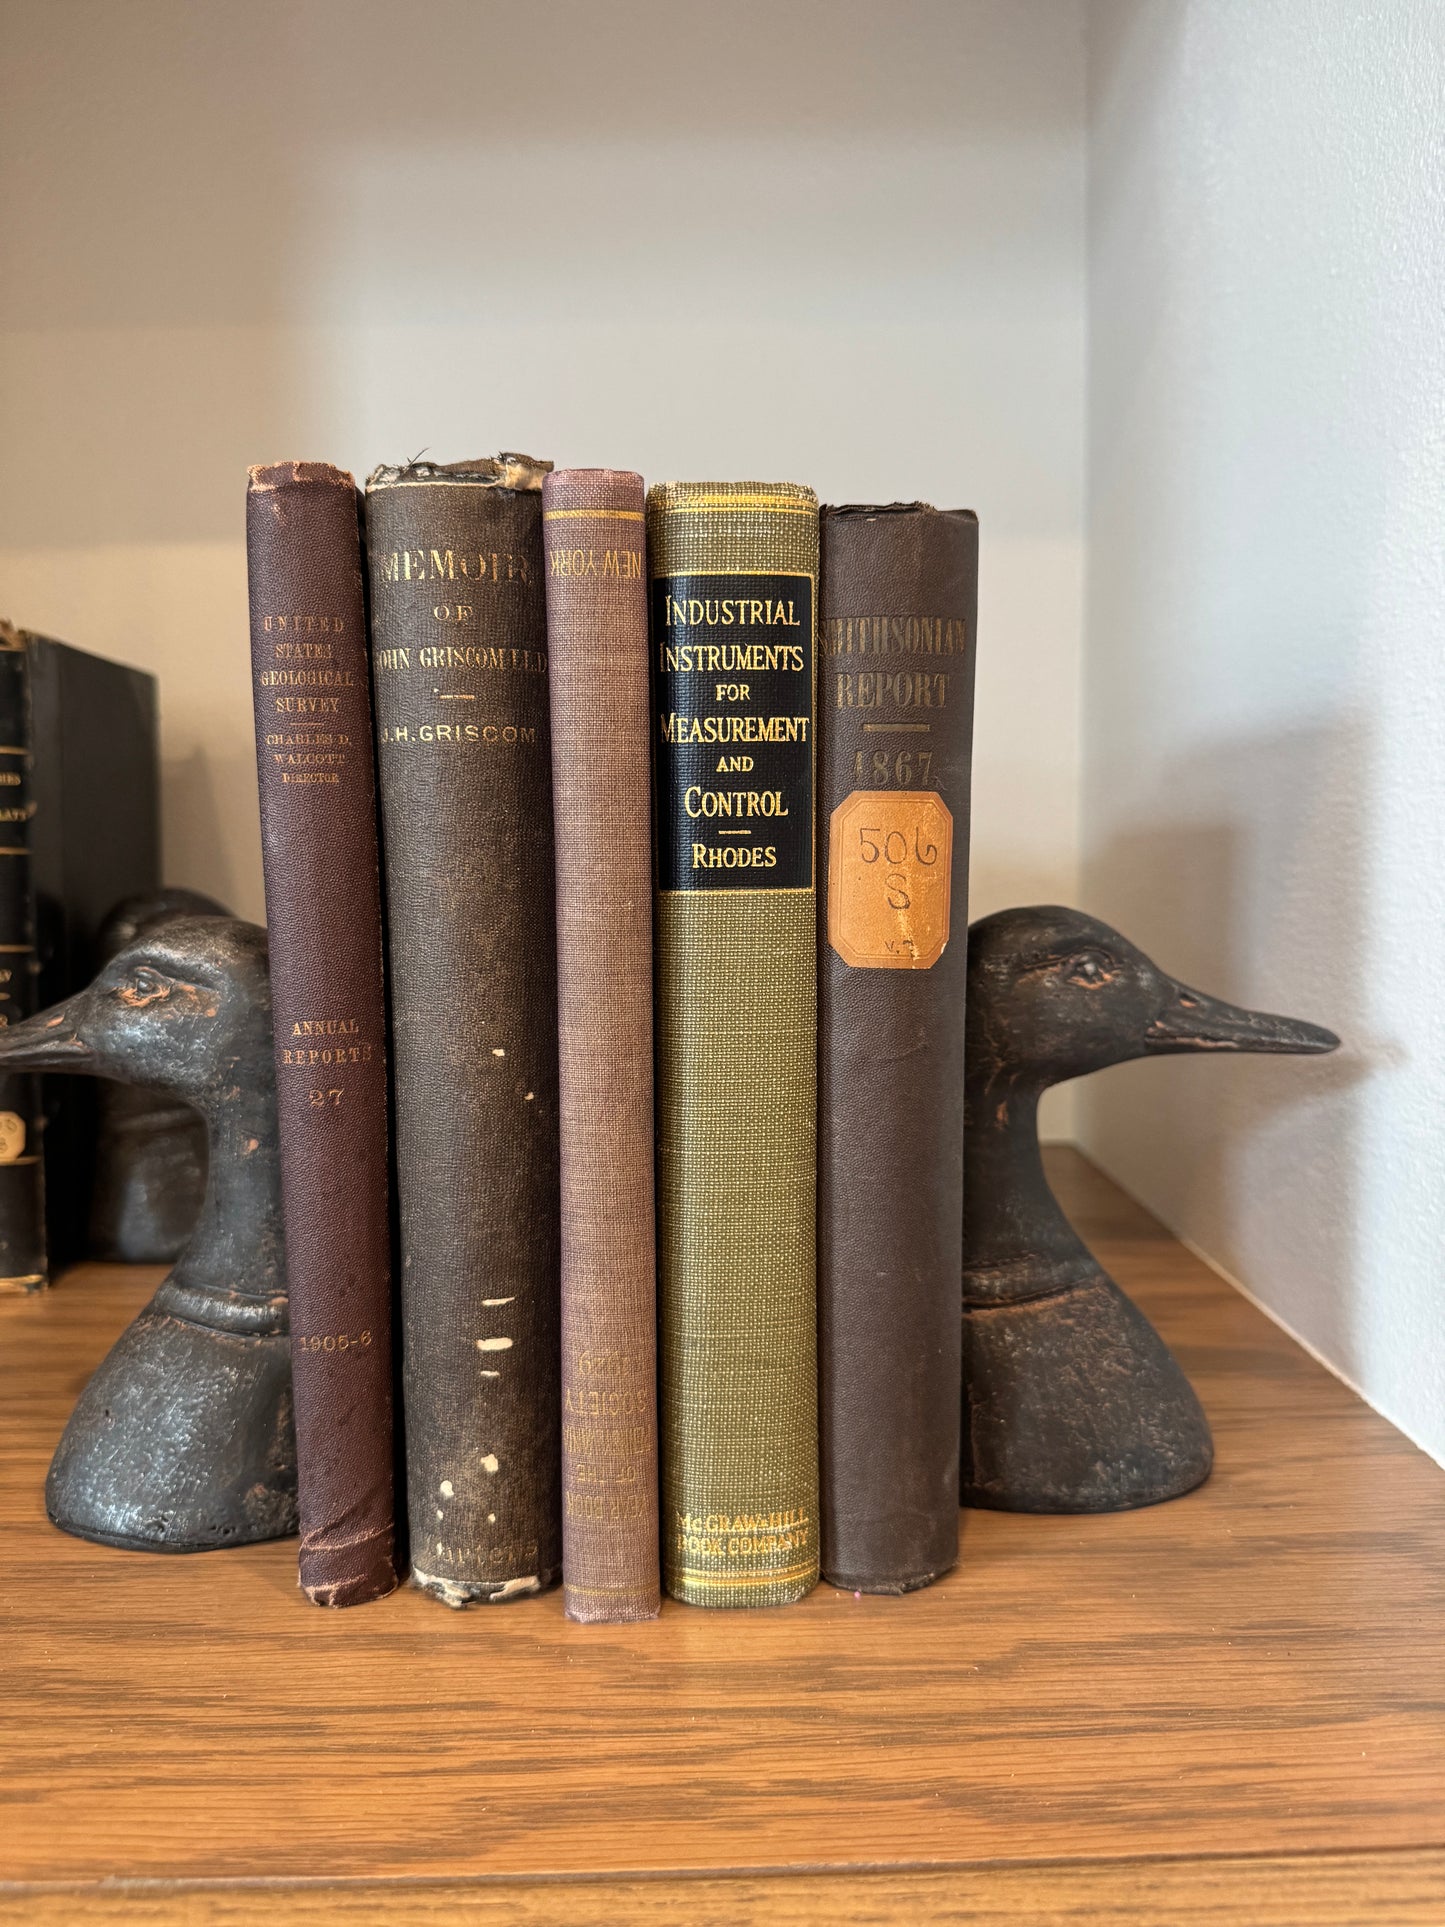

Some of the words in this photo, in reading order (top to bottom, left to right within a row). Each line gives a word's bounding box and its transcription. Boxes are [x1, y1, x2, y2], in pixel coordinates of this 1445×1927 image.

[381, 550, 531, 584] MEMOIR
[550, 549, 598, 576] YORK
[603, 549, 641, 578] NEW
[434, 605, 473, 621] OF
[665, 596, 800, 626] INDUSTRIAL
[264, 616, 344, 633] UNITED
[822, 616, 967, 656] SMITHSONIAN
[275, 643, 332, 659] STATES
[419, 646, 505, 671] GRISCOM
[660, 644, 804, 672] INSTRUMENTS
[261, 671, 353, 686] GEOLOGICAL
[836, 672, 950, 709] REPORT
[716, 684, 749, 700] FOR
[276, 698, 340, 712] SURVEY
[266, 735, 332, 745] CHARLES
[661, 713, 809, 743] MEASUREMENT
[273, 754, 345, 765] WALCOTT
[716, 757, 753, 772] AND
[854, 751, 933, 786] 1867
[685, 786, 788, 817] CONTROL
[692, 842, 777, 868] RHODES
[858, 826, 938, 866] 506
[885, 873, 911, 910] S
[292, 1019, 359, 1036] ANNUAL
[284, 1046, 372, 1064] REPORTS
[309, 1089, 345, 1106] 27
[301, 1331, 372, 1351] 1905-6
[565, 1389, 647, 1416] SOCIETY
[575, 1463, 608, 1483] THE
[616, 1465, 636, 1483] OF
[566, 1491, 603, 1519] BOOK
[677, 1534, 725, 1555] BOOK
[727, 1529, 808, 1554] COMPANY
